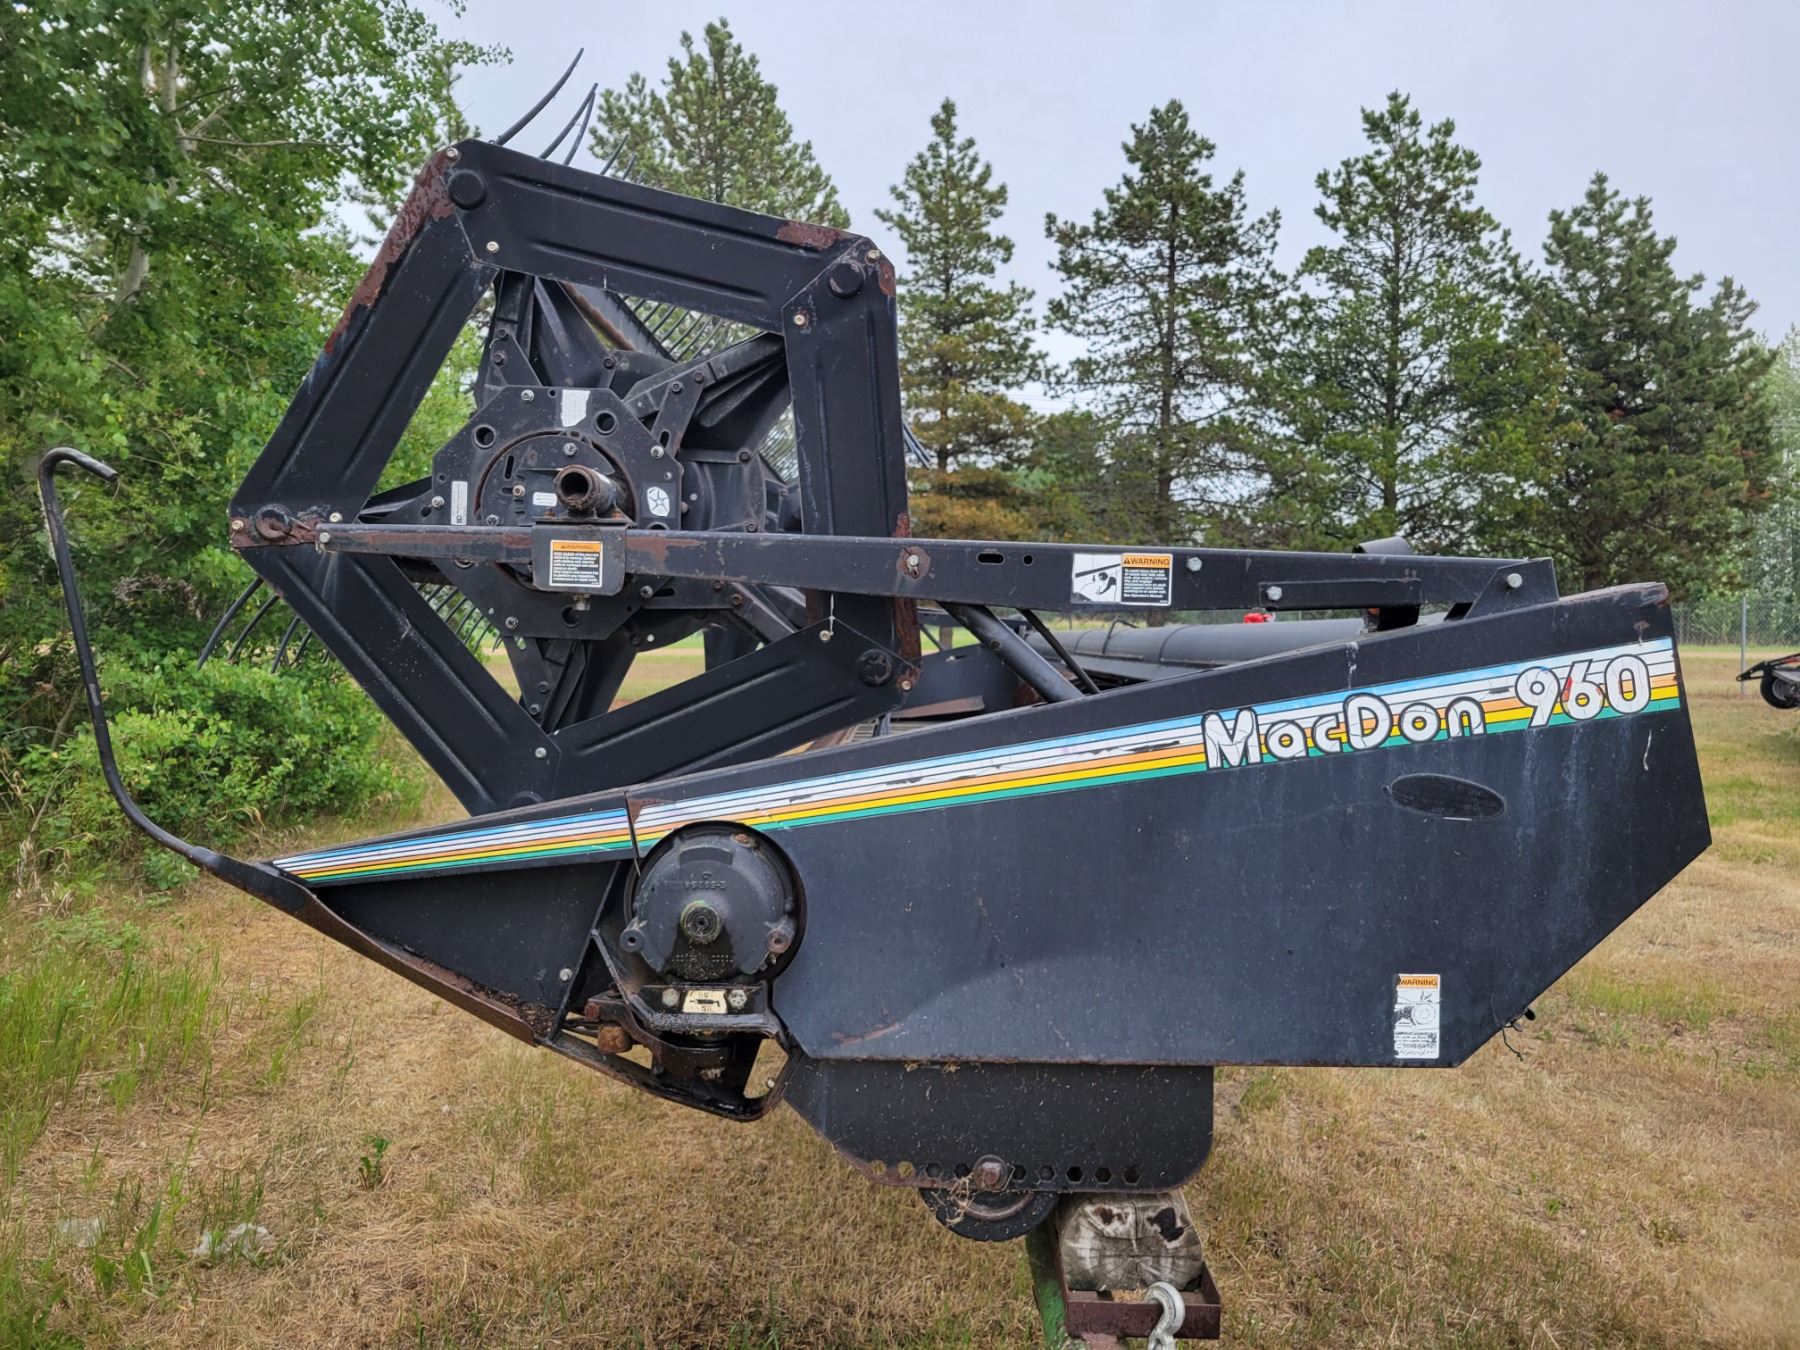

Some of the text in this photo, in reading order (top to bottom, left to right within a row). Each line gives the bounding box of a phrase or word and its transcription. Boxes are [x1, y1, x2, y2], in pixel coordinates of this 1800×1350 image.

[1130, 557, 1169, 565] WARNING
[1201, 653, 1652, 769] MacDon 960
